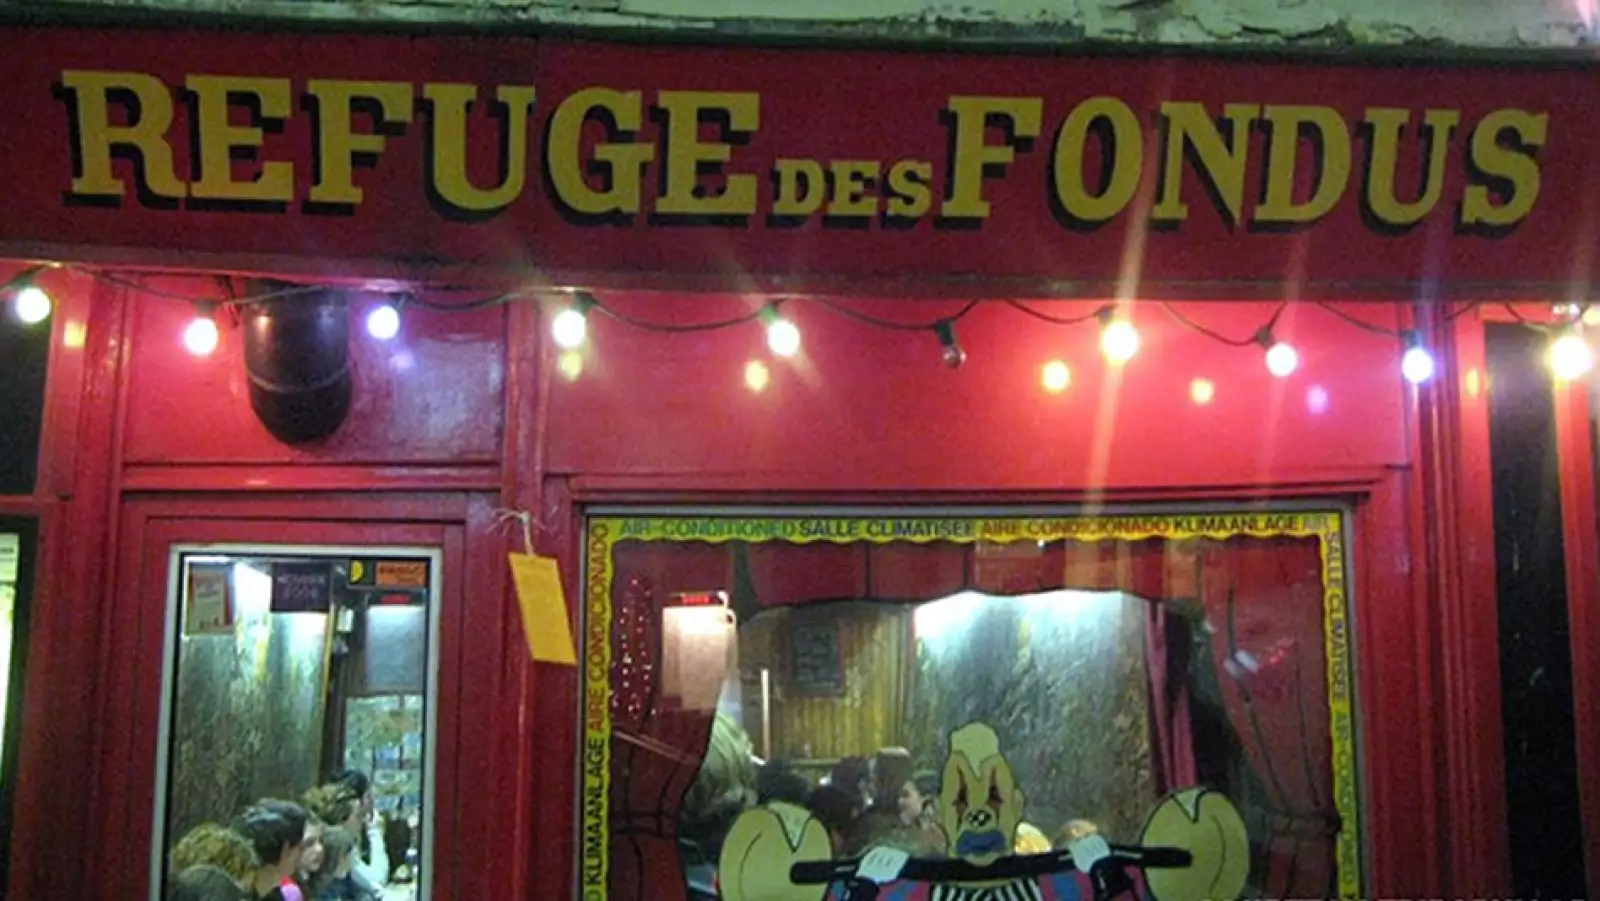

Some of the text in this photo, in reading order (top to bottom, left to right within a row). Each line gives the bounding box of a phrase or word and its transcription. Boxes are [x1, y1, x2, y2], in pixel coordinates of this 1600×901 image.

[54, 69, 1550, 236] REFUGE DES FONDUS
[799, 519, 858, 536] SALLE
[981, 518, 1015, 535] AIRE
[1023, 516, 1169, 535] CONDICIONADO
[1173, 514, 1298, 533] KLIMAANLAGE
[588, 523, 608, 682] CONDICIONADO
[587, 688, 605, 732] AIRE
[585, 738, 604, 886] KLIMAANLAGE
